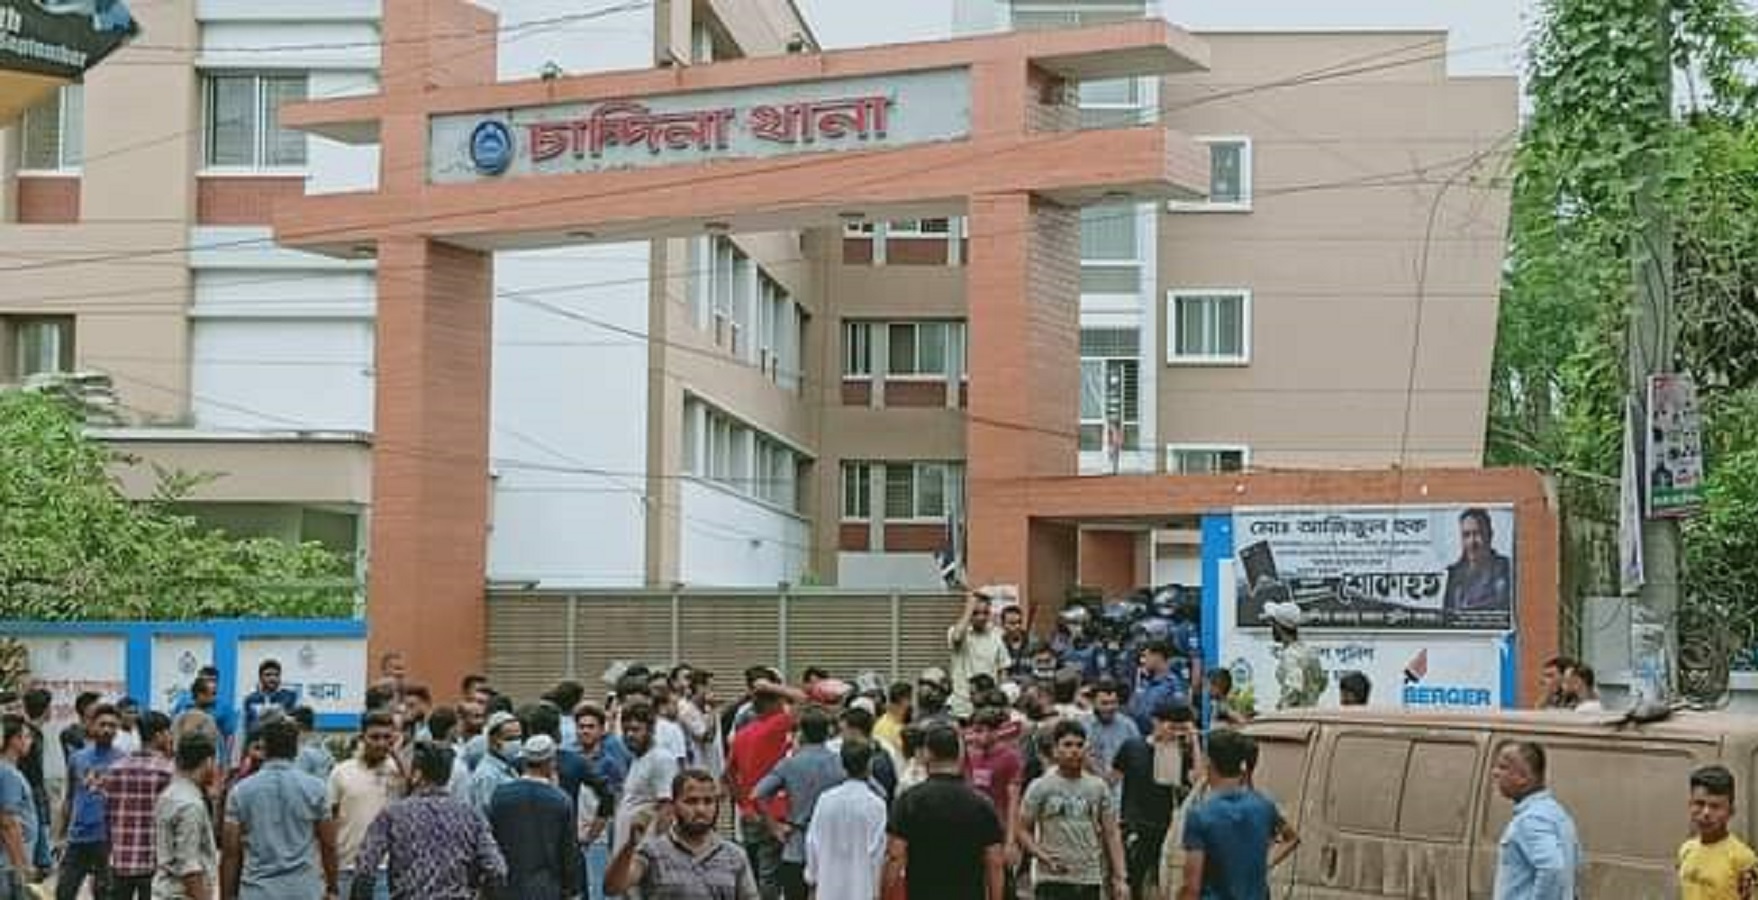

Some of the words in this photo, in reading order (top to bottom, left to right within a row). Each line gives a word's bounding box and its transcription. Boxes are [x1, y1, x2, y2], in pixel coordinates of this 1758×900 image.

[527, 99, 735, 162] চান্দিনা
[750, 95, 894, 145] থানা
[1403, 686, 1492, 706] BERGER
